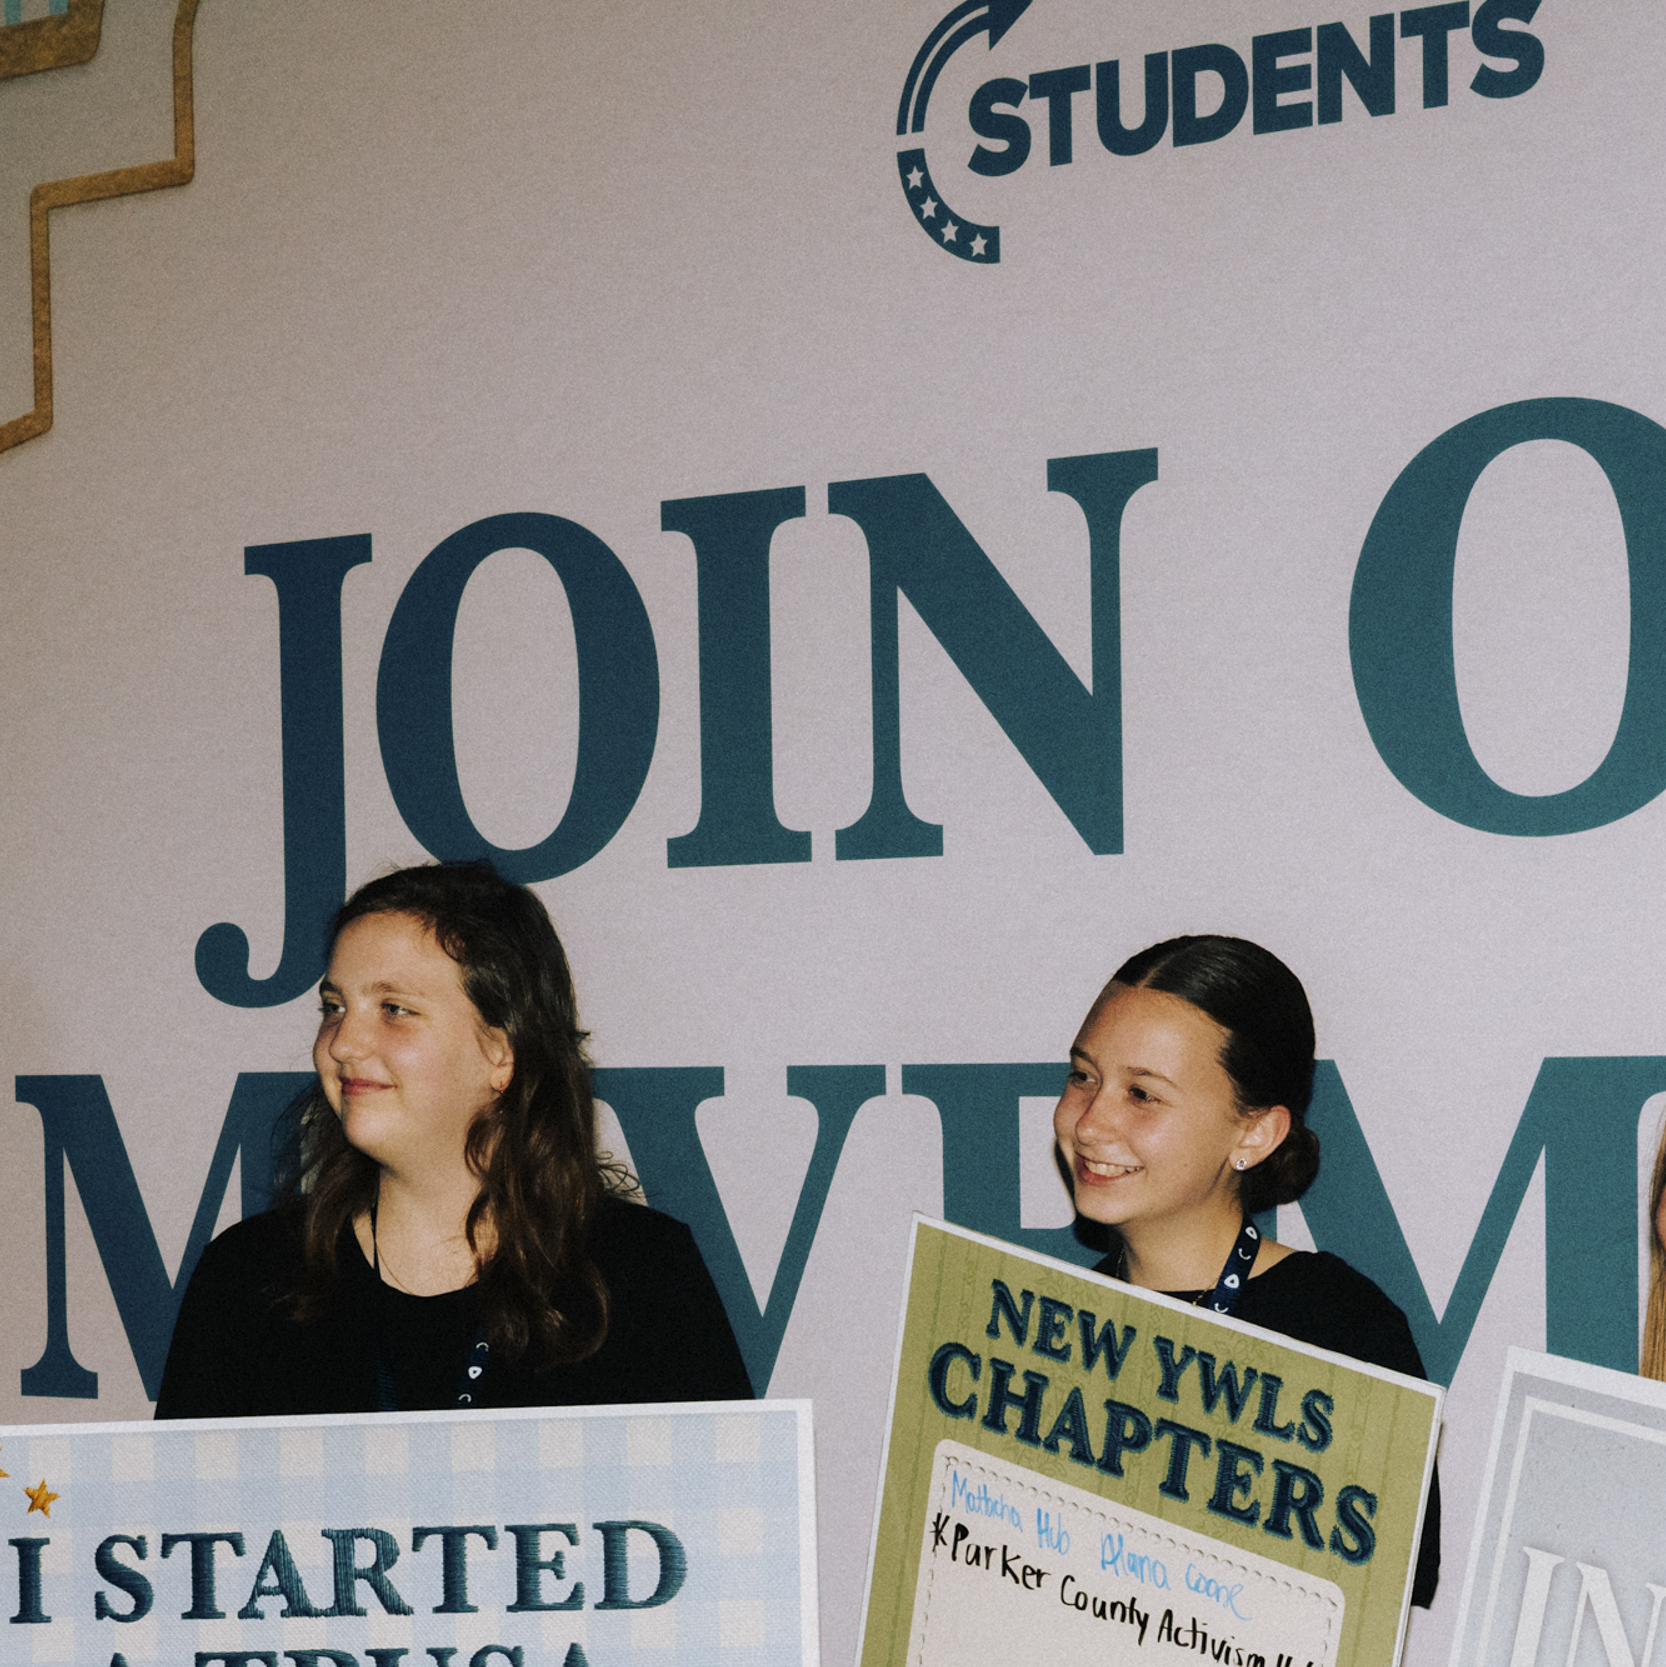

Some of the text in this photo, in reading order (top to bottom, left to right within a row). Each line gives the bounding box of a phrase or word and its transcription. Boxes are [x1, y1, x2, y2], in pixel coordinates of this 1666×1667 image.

[967, 0, 1546, 178] STUDENTS
[195, 447, 1157, 1008] JOIN
[928, 1341, 1378, 1566] CHAPTERS
[985, 1278, 1335, 1453] NEW YWLS
[8, 1519, 688, 1624] I STARTED
[951, 1522, 1051, 1591] Parker
[1060, 1575, 1150, 1647] County
